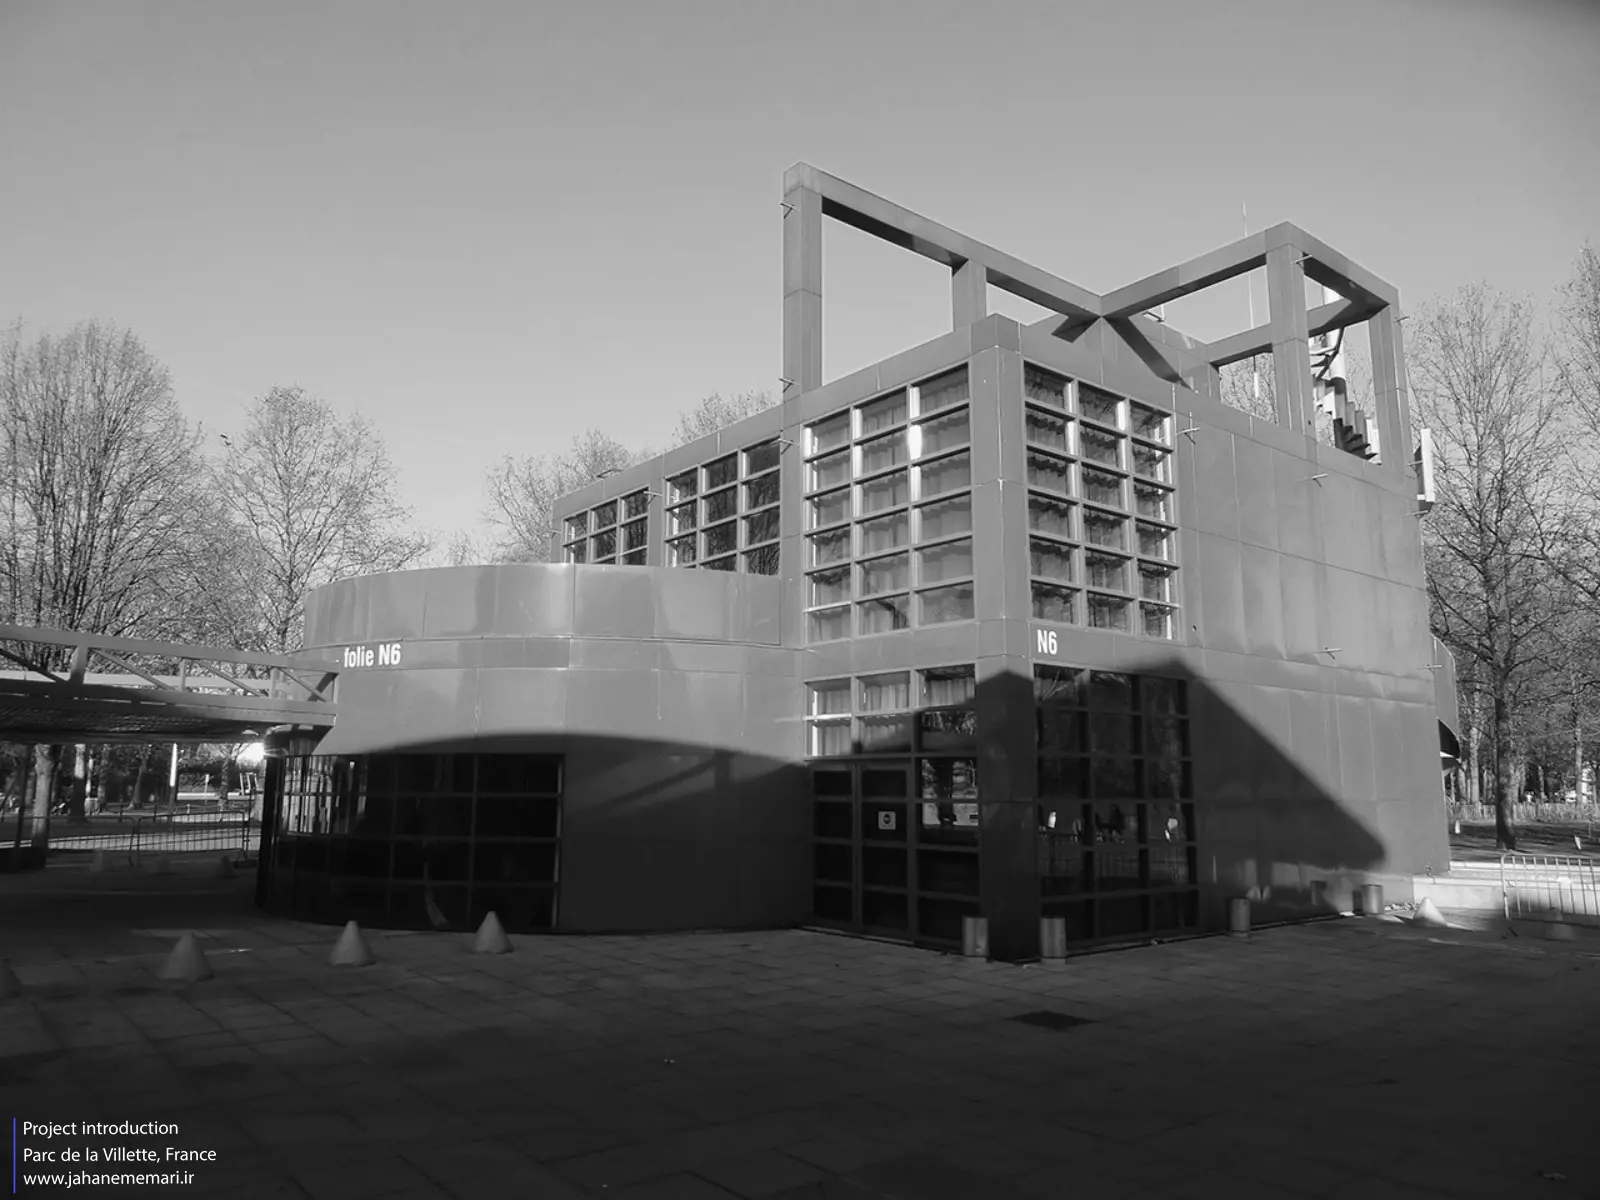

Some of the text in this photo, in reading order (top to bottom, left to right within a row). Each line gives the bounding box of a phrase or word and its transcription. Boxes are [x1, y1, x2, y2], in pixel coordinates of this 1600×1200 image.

[1037, 629, 1058, 655] N6
[343, 643, 402, 668] folie N6
